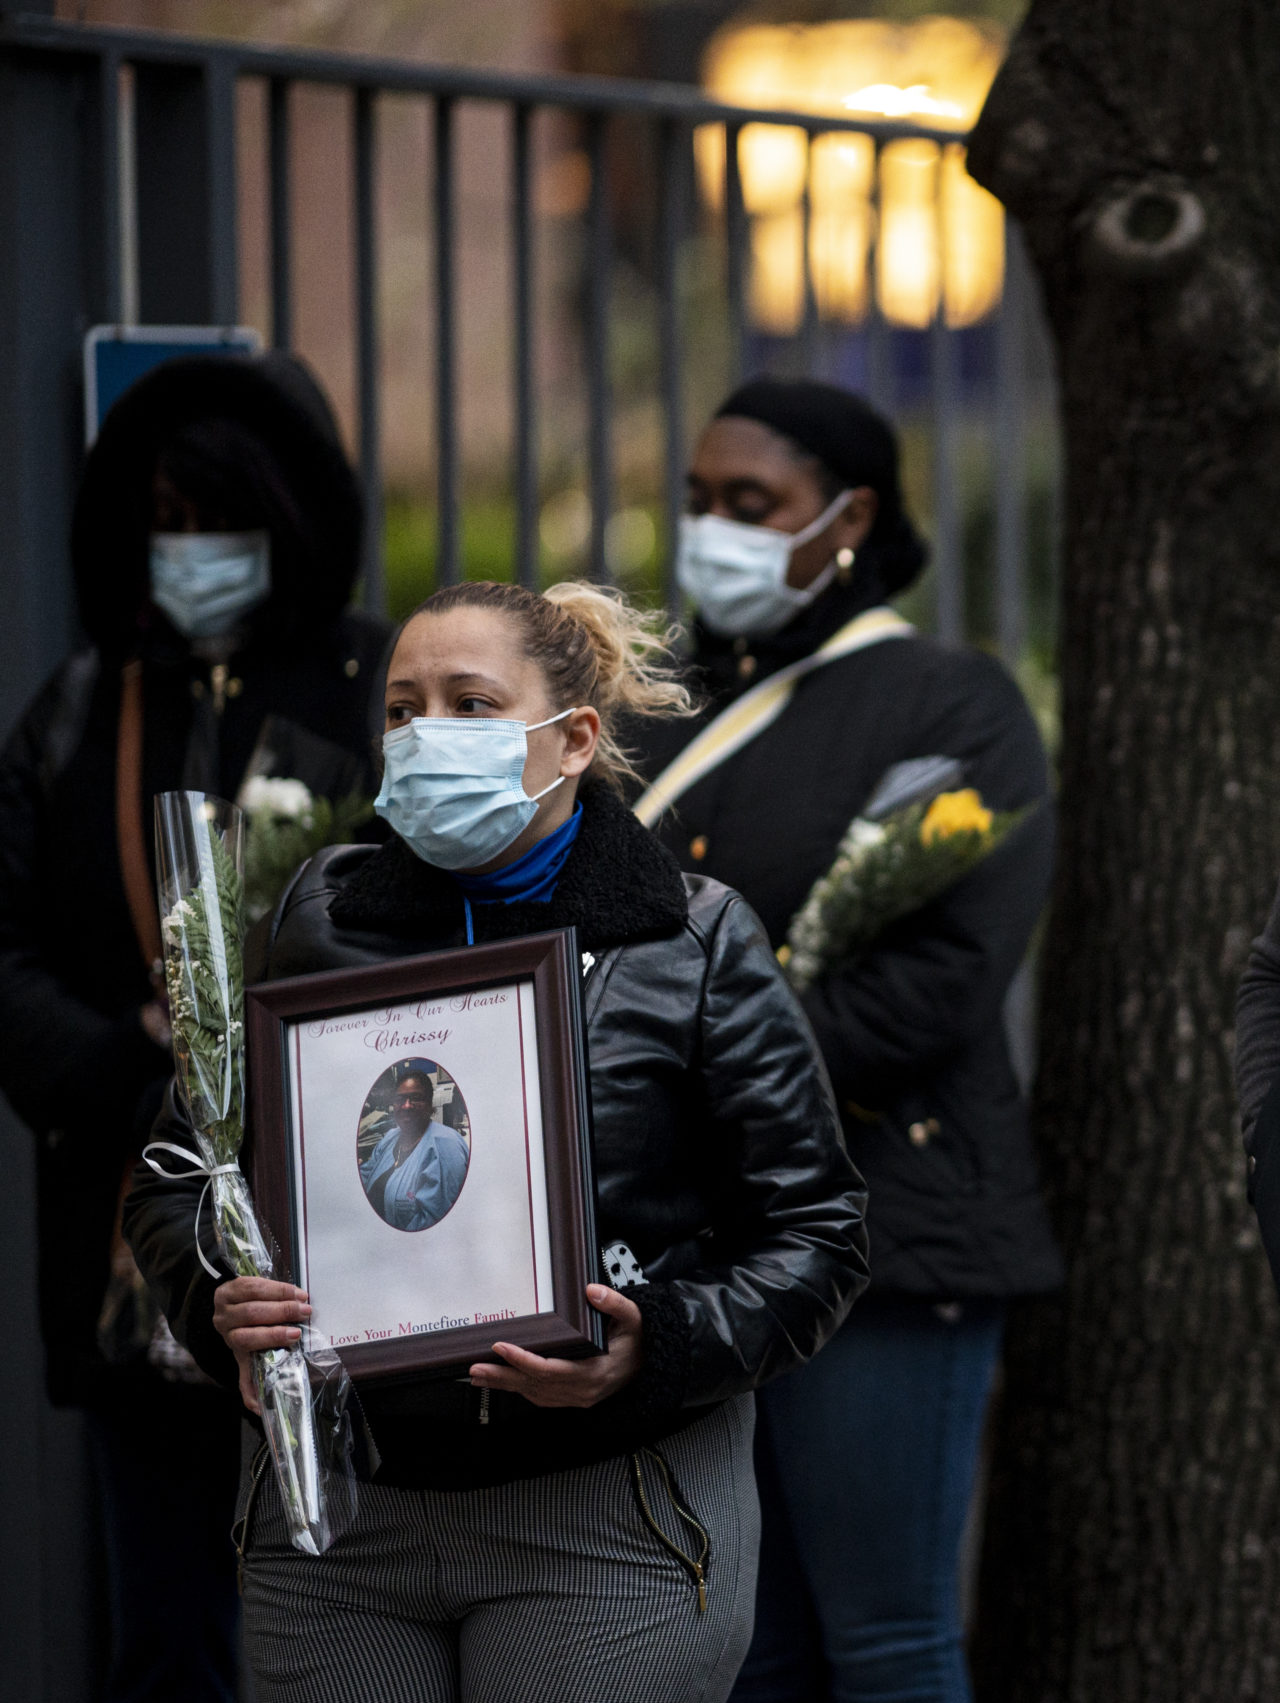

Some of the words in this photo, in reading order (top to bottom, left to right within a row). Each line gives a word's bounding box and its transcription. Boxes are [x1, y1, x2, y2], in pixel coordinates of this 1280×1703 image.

[307, 1017, 369, 1039] Forever
[374, 1007, 403, 1026] In
[409, 1000, 444, 1020] Our
[450, 991, 509, 1012] Hearts
[364, 1027, 452, 1052] Chrissy
[330, 1334, 359, 1346] Love
[364, 1328, 393, 1340] Your
[398, 1315, 470, 1336] Montefiore
[474, 1308, 517, 1325] Family
